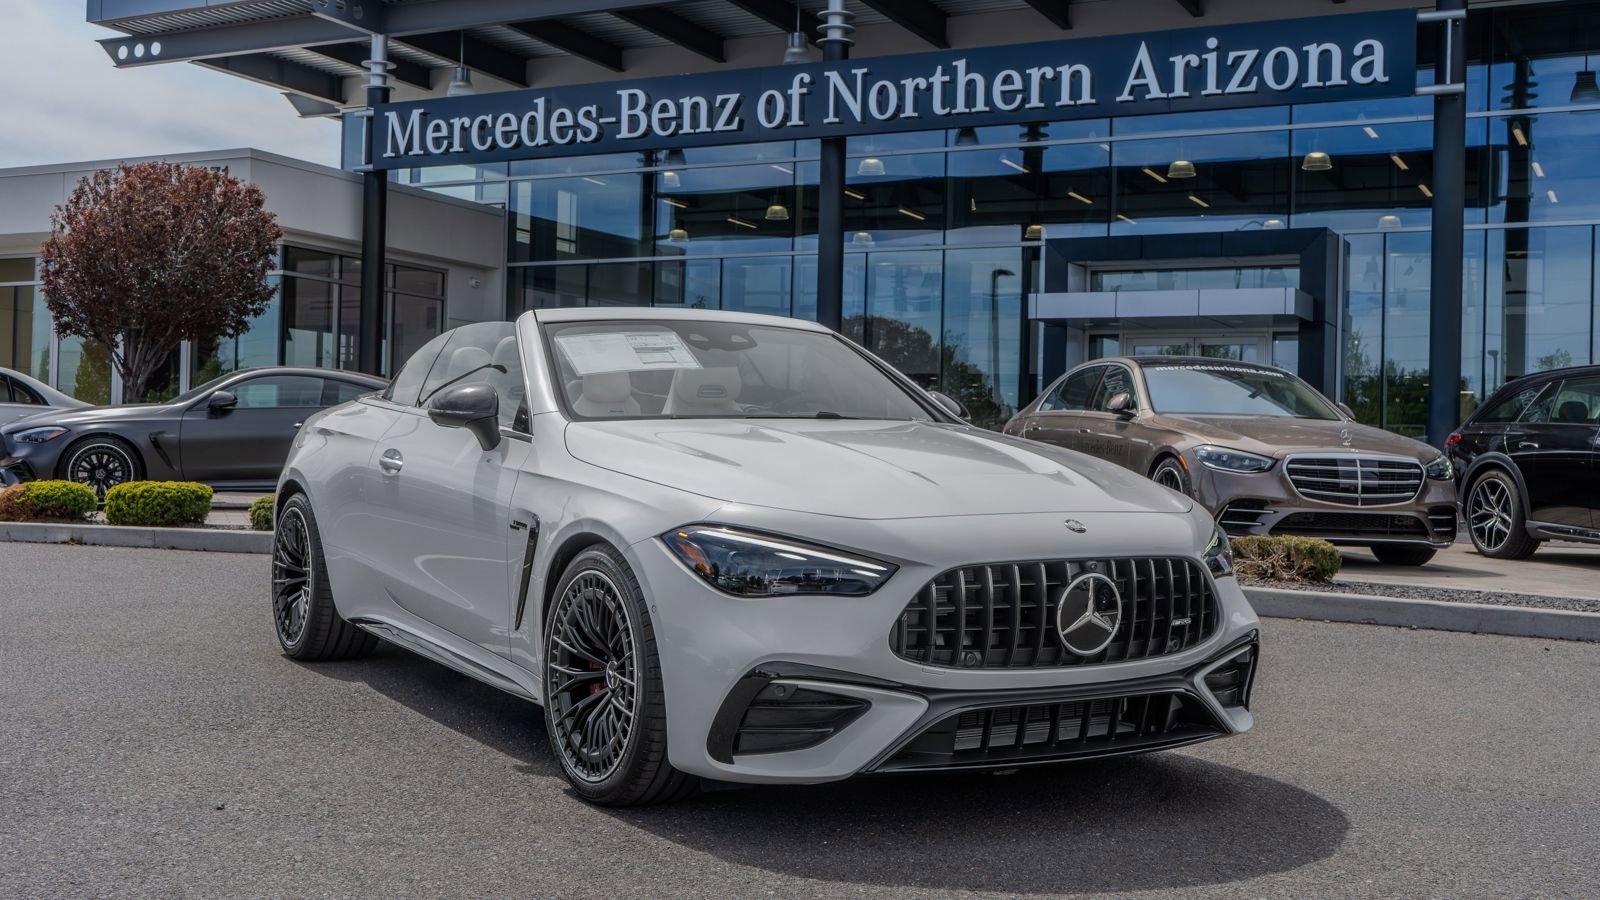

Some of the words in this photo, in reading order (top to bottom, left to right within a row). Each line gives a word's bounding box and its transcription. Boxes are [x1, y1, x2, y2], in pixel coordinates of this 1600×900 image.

[382, 88, 741, 158] Mercedes-Benz
[757, 72, 812, 128] of
[823, 56, 1096, 124] Northern
[1115, 37, 1390, 102] Arizona
[1155, 365, 1285, 378] mercedesarizona.com
